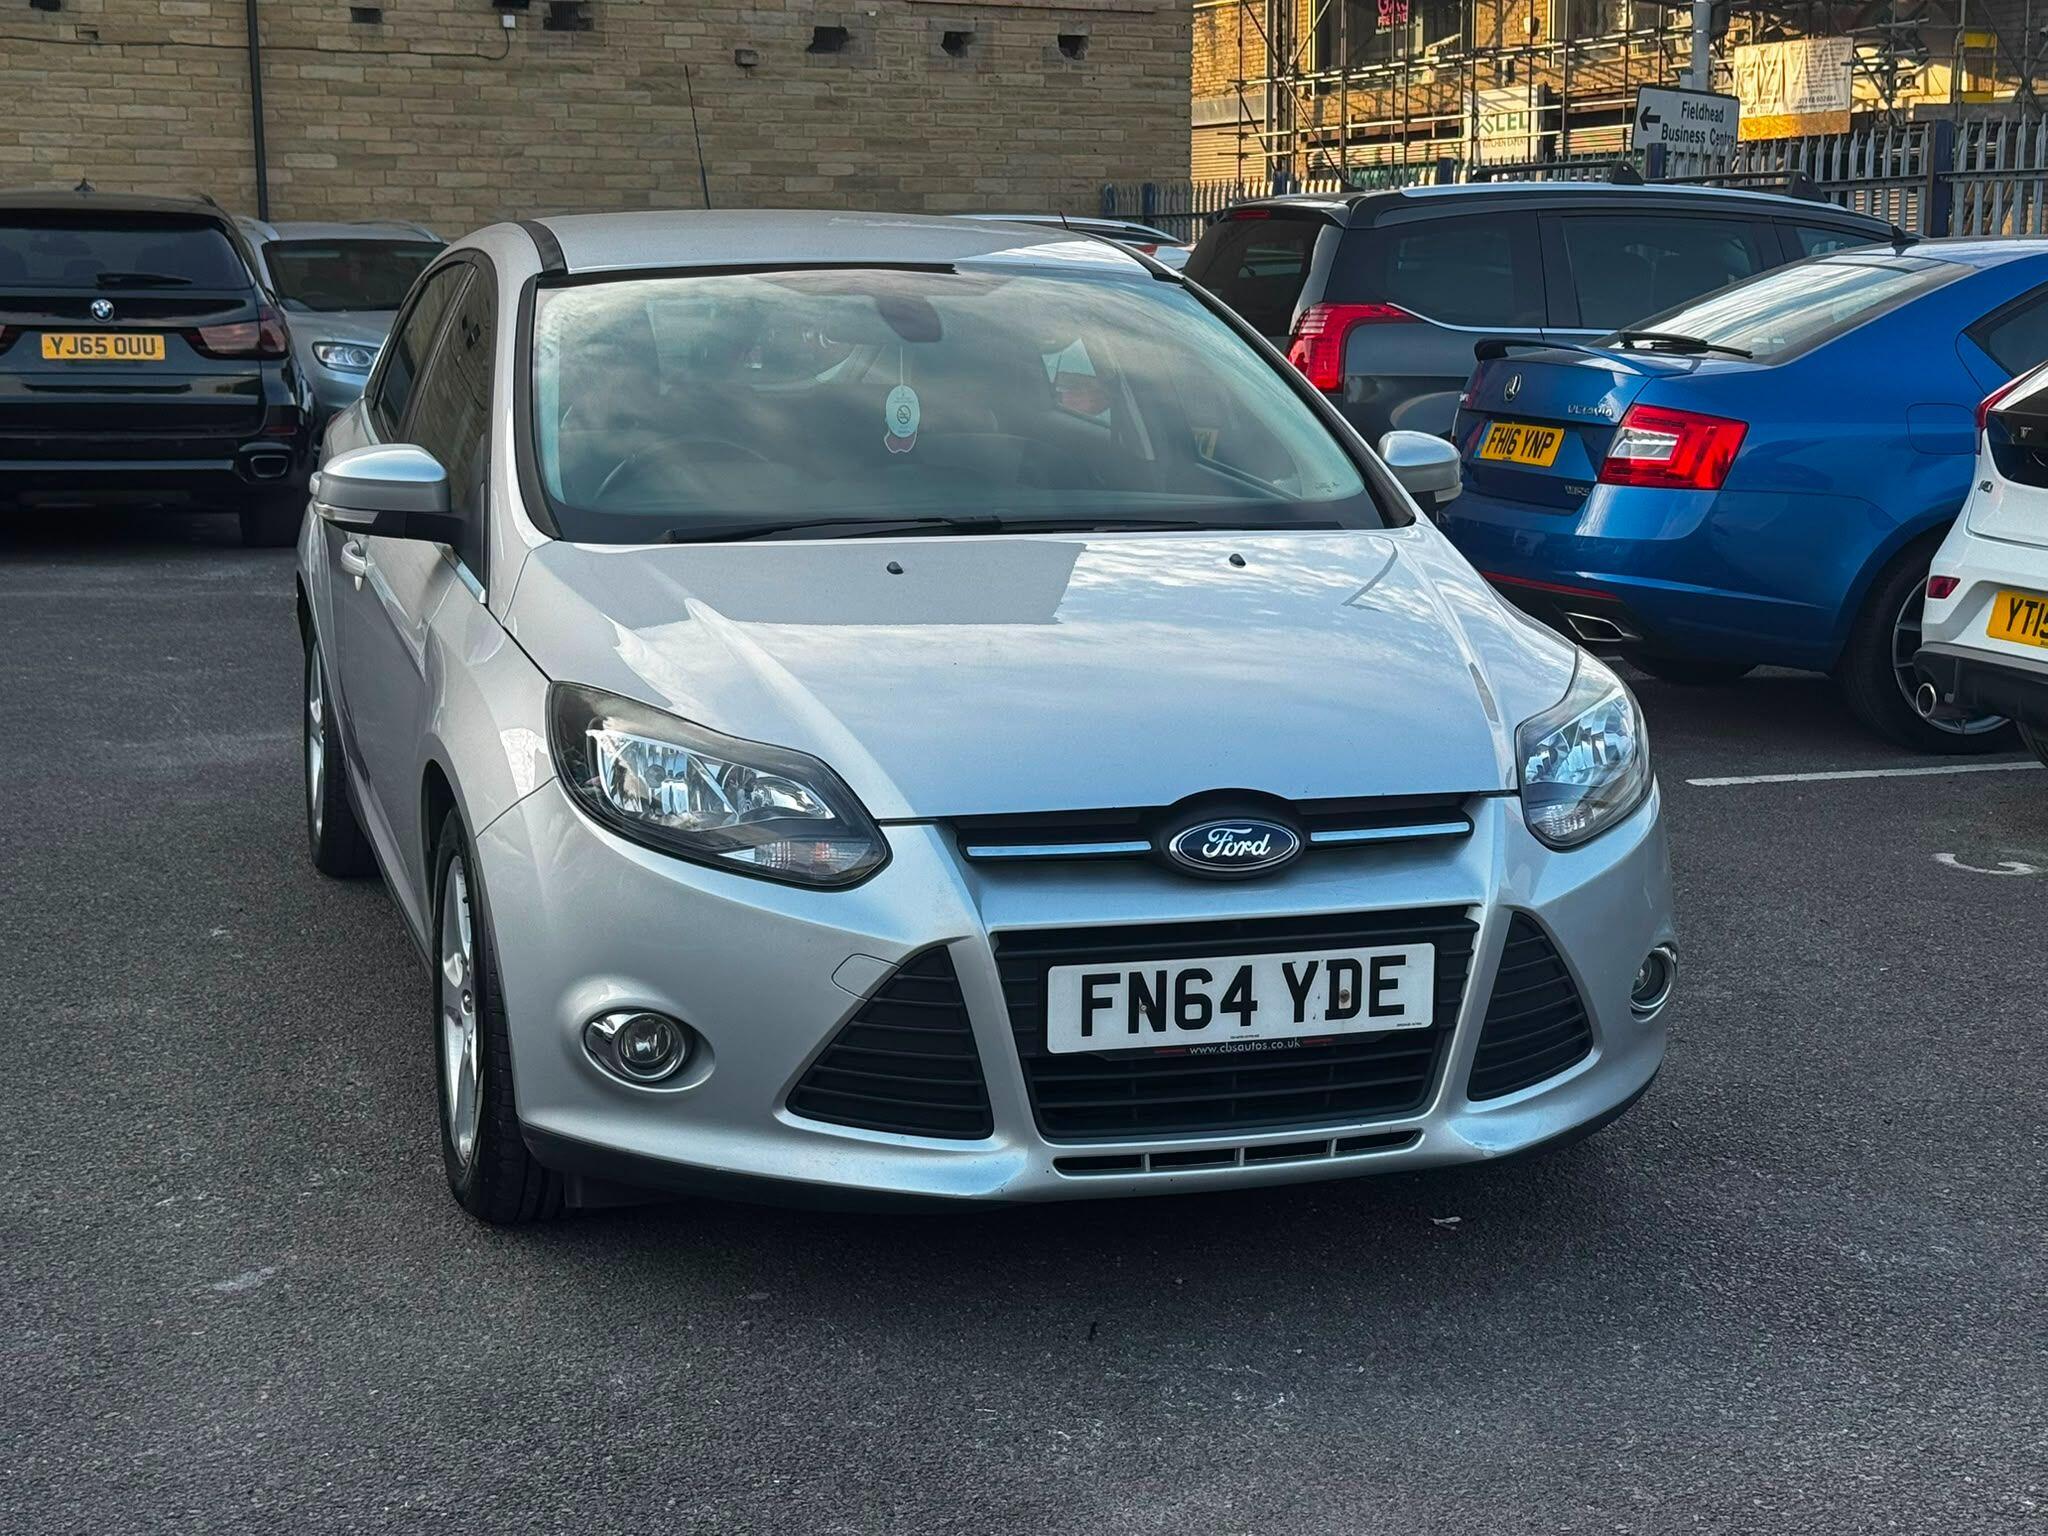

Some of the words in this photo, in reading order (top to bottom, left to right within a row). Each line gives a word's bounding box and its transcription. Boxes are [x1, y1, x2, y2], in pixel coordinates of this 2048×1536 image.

[1681, 101, 1725, 123] Fieldhead
[1661, 123, 1706, 145] Business
[50, 336, 108, 355] YJ65
[114, 336, 156, 355] OUU
[1485, 427, 1521, 456] FH16
[1520, 429, 1556, 459] YNP
[1202, 827, 1271, 858] Ford
[1080, 964, 1258, 1038] FN64
[1281, 954, 1407, 1024] YDE
[1189, 1037, 1301, 1055] www.cbsautos.co.uk
